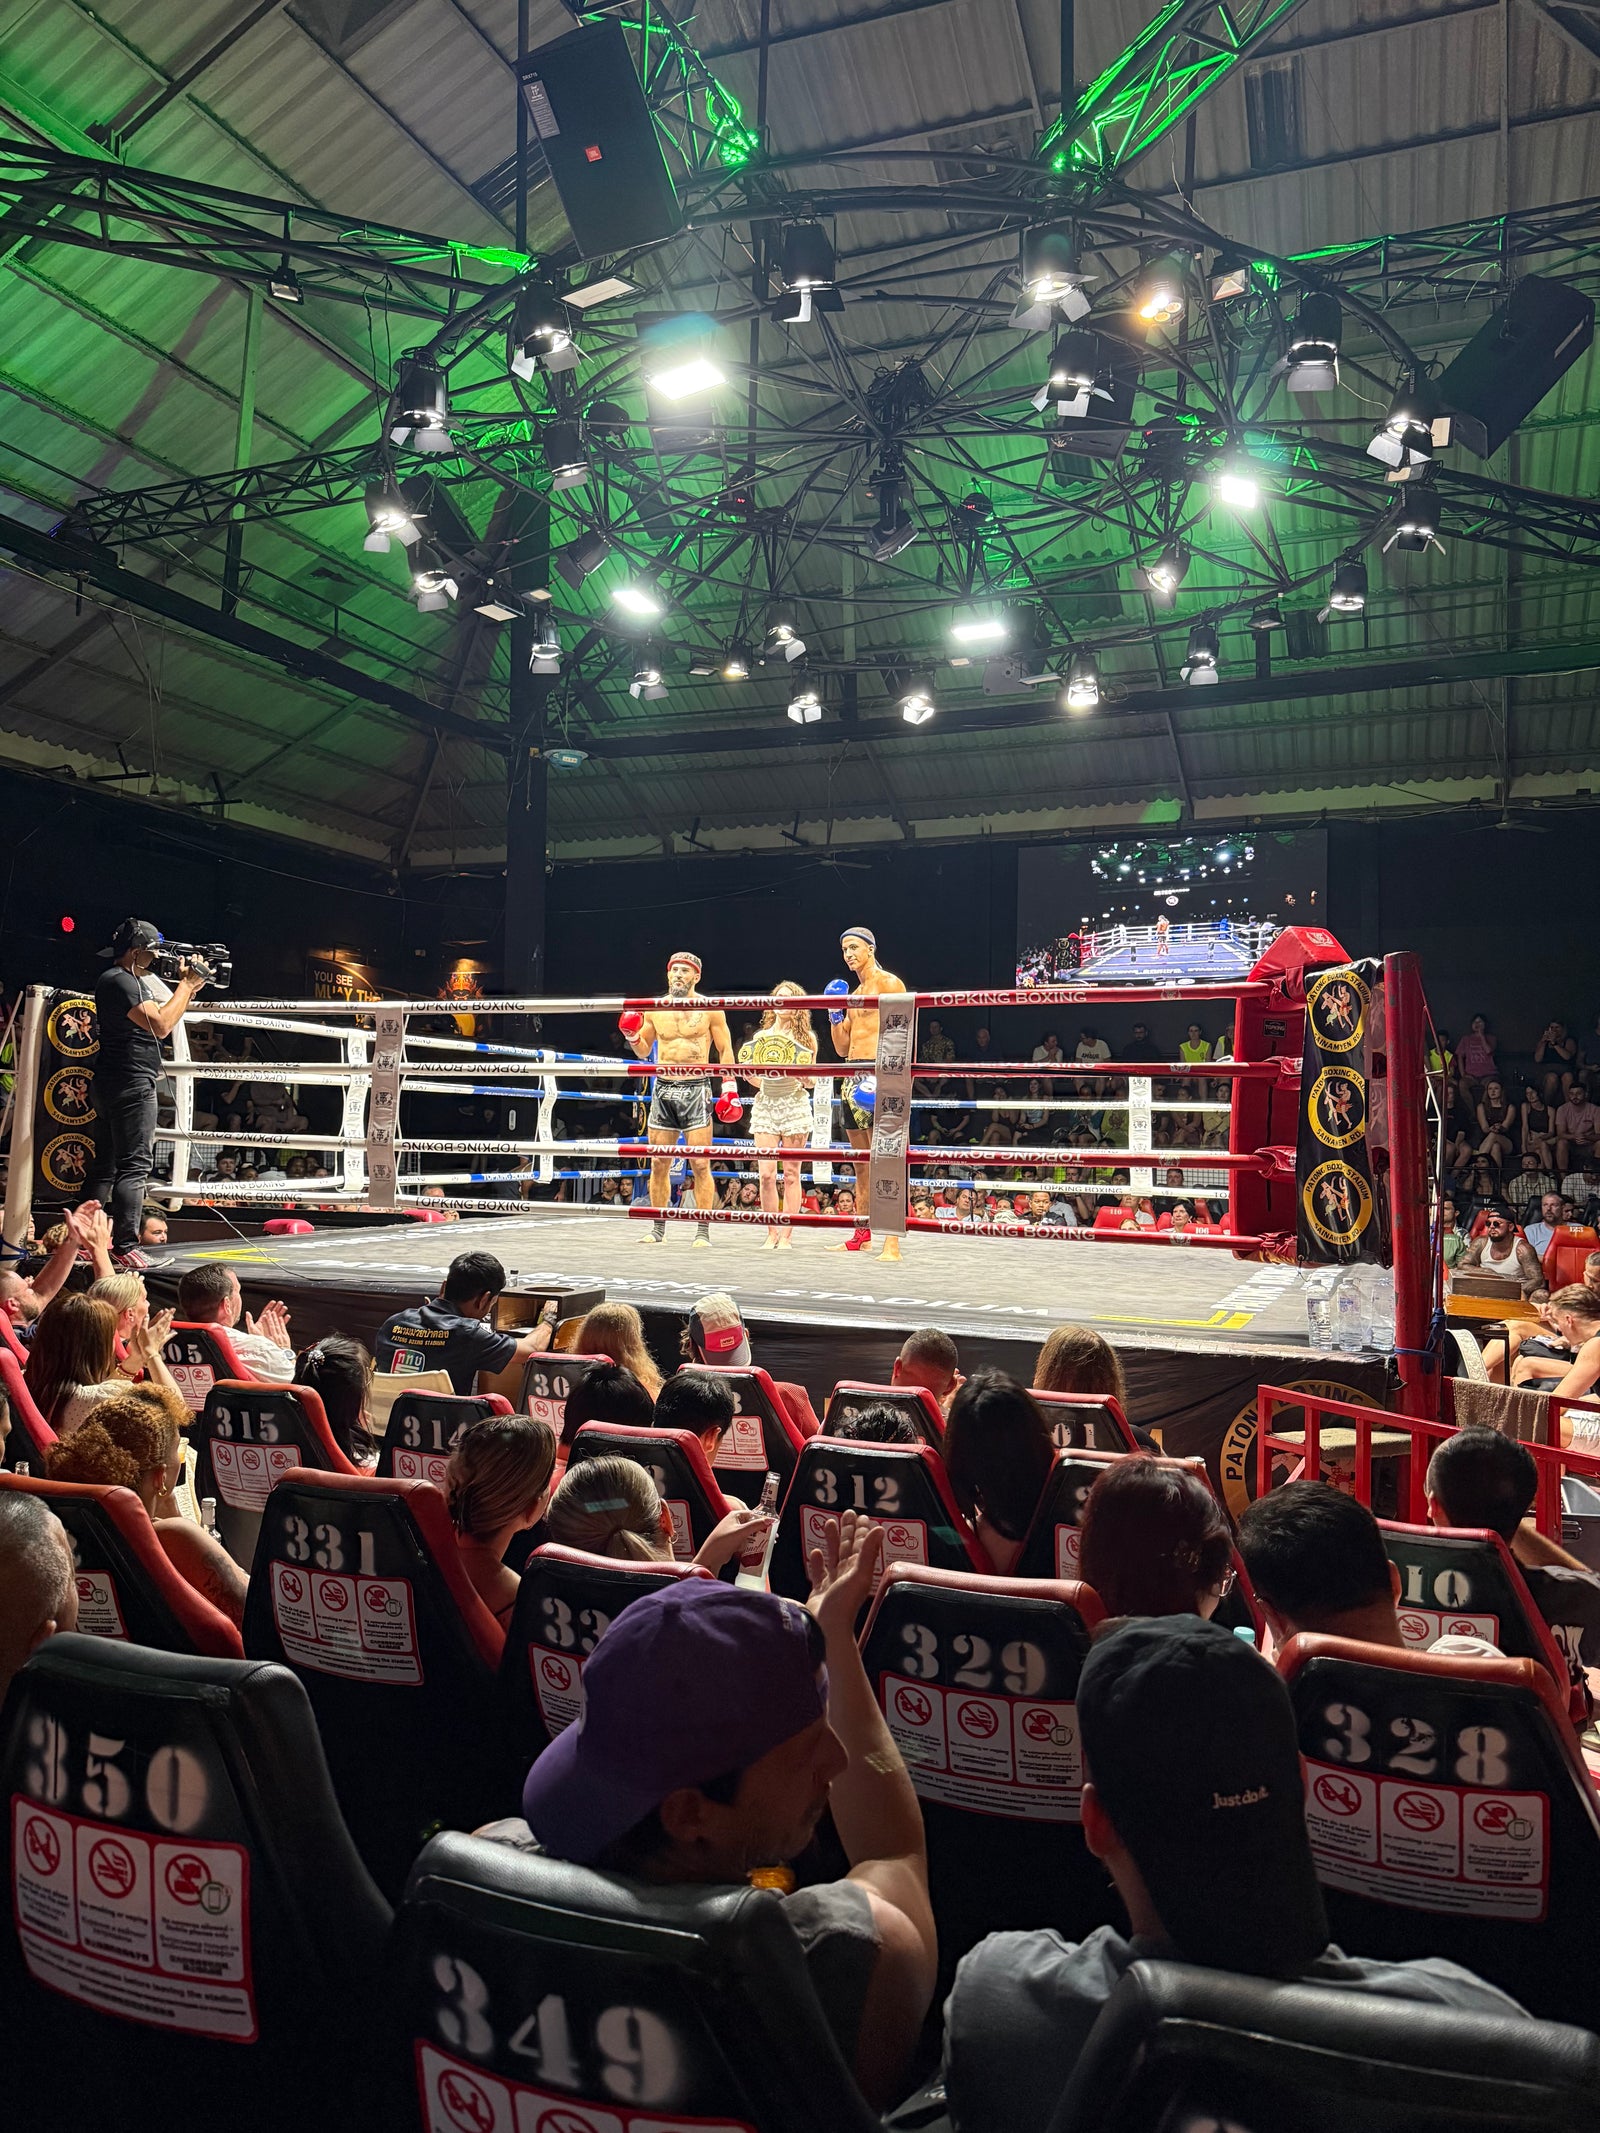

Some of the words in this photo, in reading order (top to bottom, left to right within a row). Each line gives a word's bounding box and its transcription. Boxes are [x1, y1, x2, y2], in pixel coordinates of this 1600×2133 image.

[314, 970, 333, 983] YOU
[335, 975, 353, 987] SEE
[1327, 971, 1349, 982] BOXING
[1350, 976, 1371, 1004] STADIUM
[410, 1001, 469, 1011] TOPKING
[472, 1001, 526, 1011] BOXING
[653, 998, 720, 1008] TOPKING
[724, 998, 785, 1008] BOXING
[930, 993, 1011, 1006] TOPKING
[1016, 991, 1087, 1004] BOXING
[412, 1063, 463, 1072] BOXING
[467, 1063, 530, 1074] TOPKING
[656, 1067, 714, 1077] BOXING
[1312, 1077, 1326, 1099] PATO
[1324, 1069, 1351, 1077] BOXING
[401, 1141, 454, 1151] BOXING
[457, 1143, 519, 1153] TOPKING
[647, 1144, 705, 1154] BOXING
[709, 1146, 780, 1156] TOPKING
[927, 1149, 995, 1160] BOXING
[1001, 1151, 1085, 1163] TOPKING
[924, 1179, 958, 1188] BOXING
[1040, 1184, 1083, 1193] TOPKING
[1087, 1186, 1123, 1194] BOXING
[1306, 1167, 1326, 1193] PATONG
[1346, 1169, 1370, 1201] STADIUM
[200, 1192, 253, 1202] TOPKING
[255, 1192, 303, 1202] BOXING
[415, 1197, 474, 1210] TOPKING
[477, 1200, 531, 1212] BOXING
[658, 1208, 726, 1221] TOPKING
[730, 1213, 791, 1225] BOXING
[939, 1220, 1019, 1238] TOPKING
[1024, 1225, 1096, 1241] BOXING
[764, 1289, 1049, 1316] STADIUM
[391, 1336, 408, 1344] PATONG
[533, 1373, 571, 1398] 30
[215, 1406, 280, 1443] 315
[1051, 1422, 1097, 1449] 01
[1226, 1408, 1259, 1481] PATON
[814, 1468, 900, 1513] 312
[283, 1514, 377, 1577] 331
[1404, 1565, 1472, 1608] 10
[543, 1597, 611, 1652] 33
[902, 1623, 1046, 1696] 329
[1325, 1703, 1509, 1787] 328
[27, 1714, 209, 1833] 350
[1212, 1791, 1241, 1809] Just
[1242, 1788, 1258, 1804] do
[432, 1954, 681, 2103] 349
